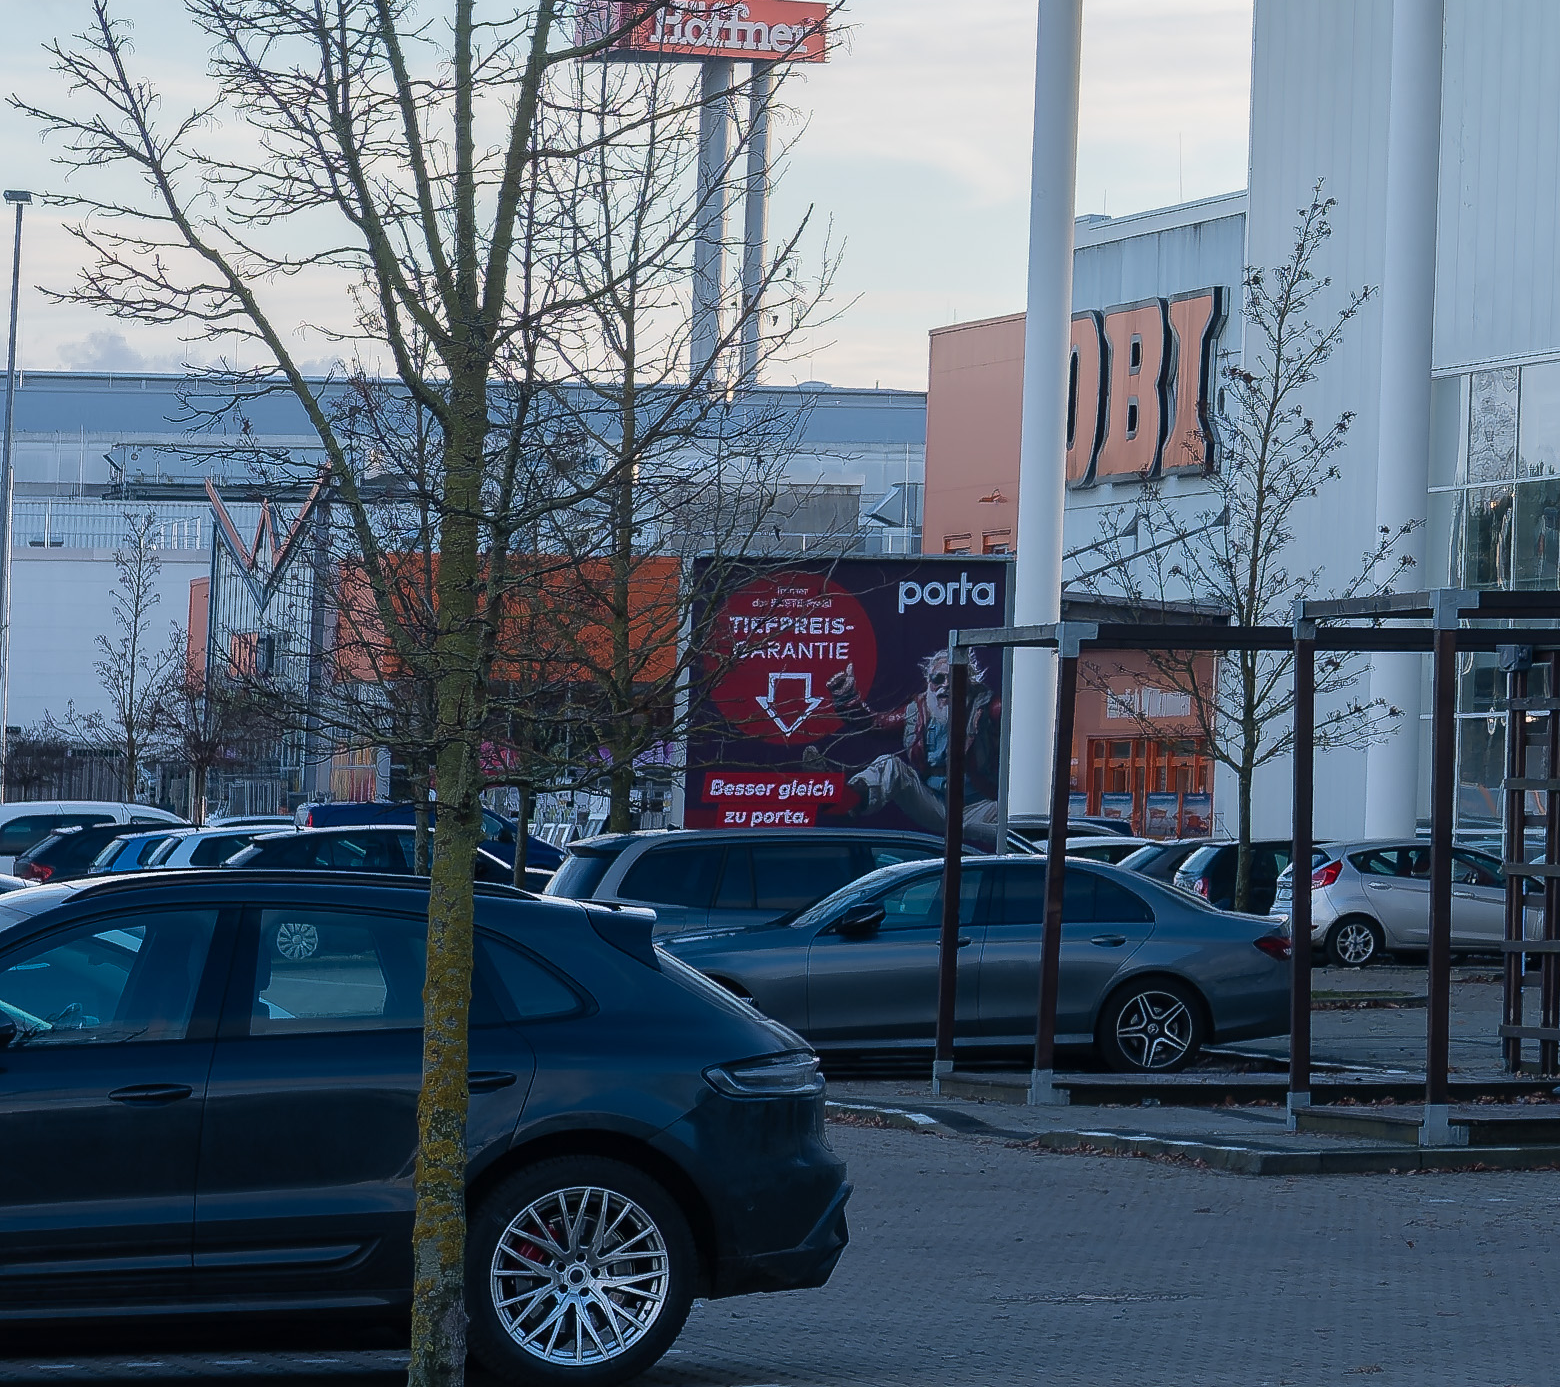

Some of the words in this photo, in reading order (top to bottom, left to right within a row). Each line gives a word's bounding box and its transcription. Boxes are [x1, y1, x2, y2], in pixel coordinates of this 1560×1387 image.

[898, 572, 997, 614] porta
[729, 616, 855, 636] TIEFPREIS-
[733, 641, 850, 660] GARANTIE
[709, 778, 773, 797] Besser
[778, 779, 835, 800] gleich
[723, 810, 747, 825] zu
[750, 808, 810, 827] porta.
